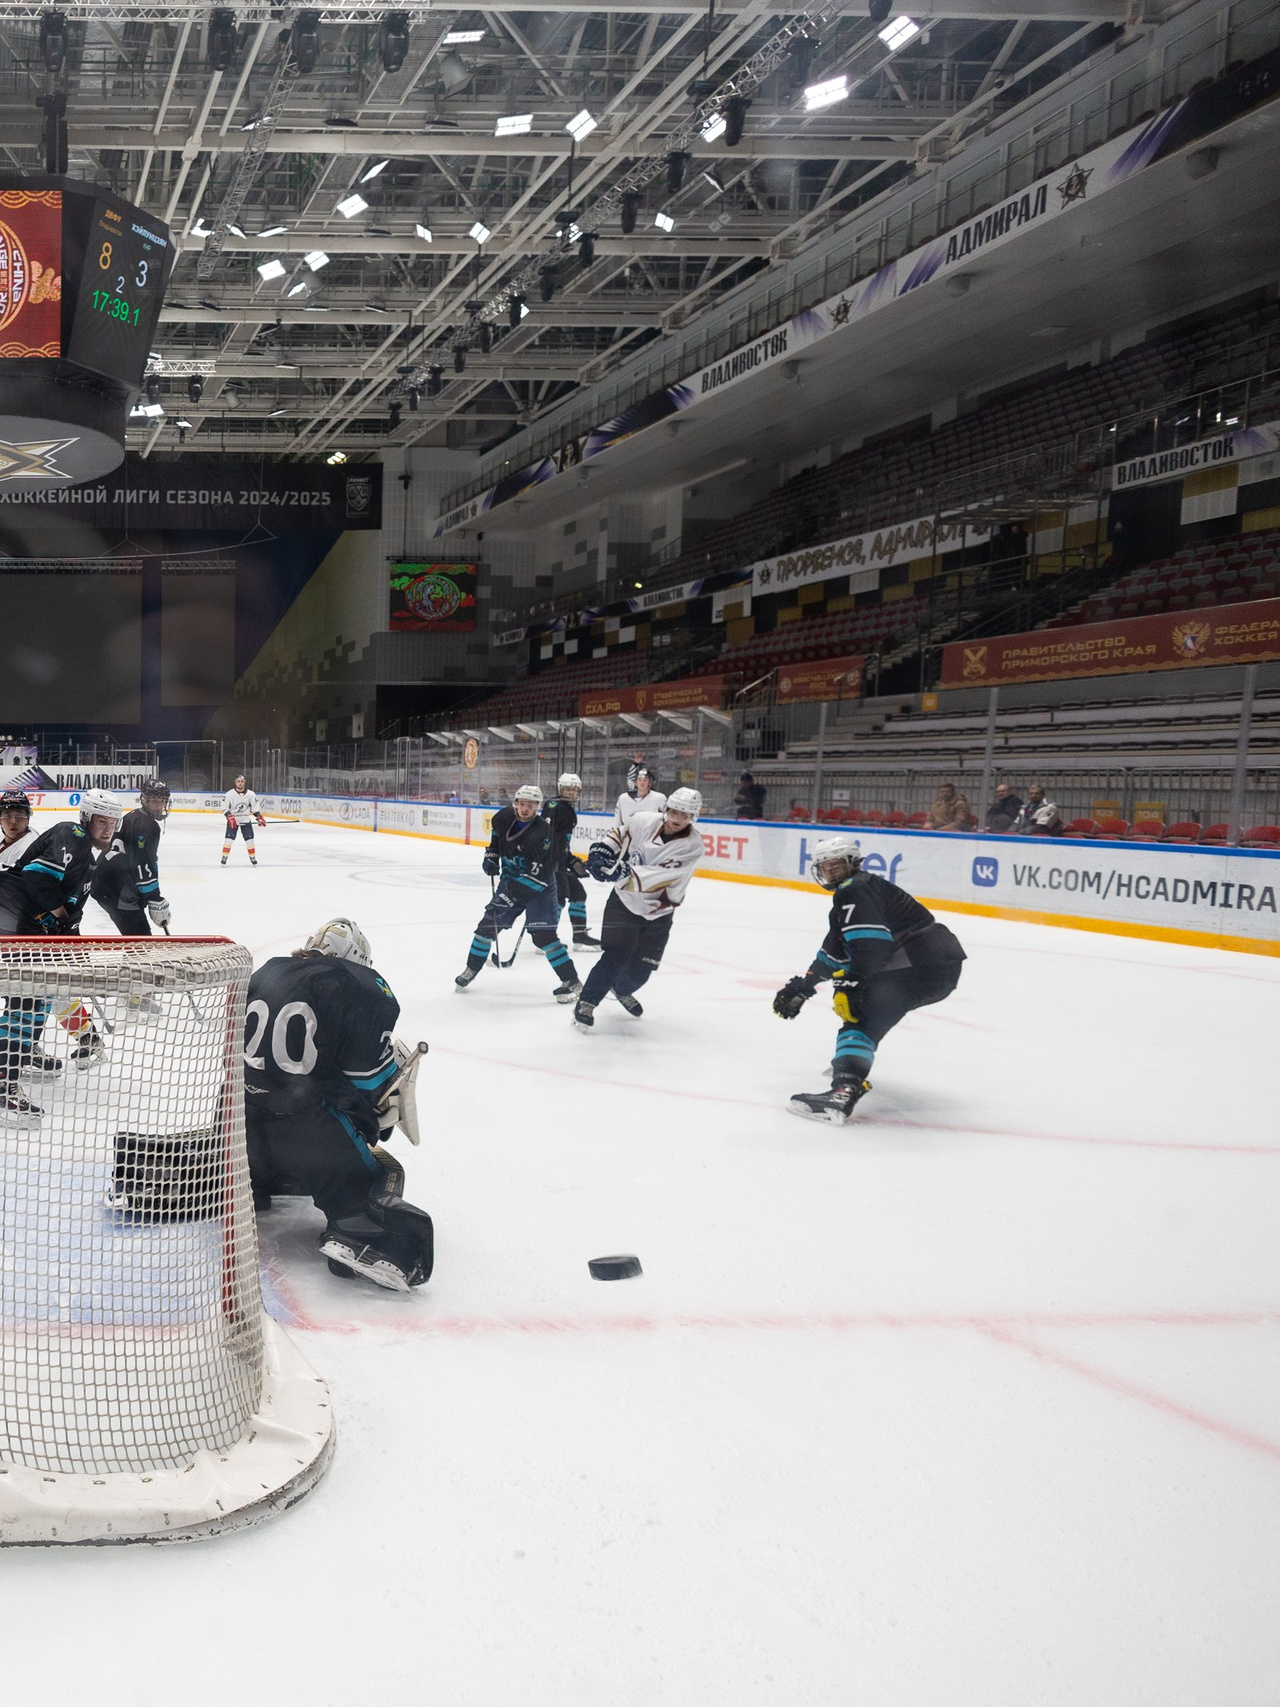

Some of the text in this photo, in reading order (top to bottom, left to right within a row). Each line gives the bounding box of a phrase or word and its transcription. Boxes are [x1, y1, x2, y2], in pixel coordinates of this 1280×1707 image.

[945, 184, 1048, 265] АДМИРАЛ
[99, 242, 113, 270] 8
[115, 276, 125, 294] 2
[135, 260, 148, 287] 3
[93, 290, 139, 326] 17:39.1
[701, 328, 788, 393] ВЛАДИВОСТОК
[1117, 436, 1234, 485] ВЛАДИВОСТОК
[113, 490, 159, 504] ЛИГИ
[166, 490, 234, 505] СЕЗОНА
[238, 490, 331, 506] 2024/2025
[1001, 636, 1126, 659] ПРАВИТЕЛЬСТВО
[1213, 631, 1278, 646] ХОККЕЯ
[1001, 645, 1156, 670] ПРИМОРСКОГО КРАЯ
[585, 702, 621, 715] СХЛ.РФ
[799, 838, 902, 884] Her
[842, 903, 856, 923] 7
[244, 999, 319, 1076] 20
